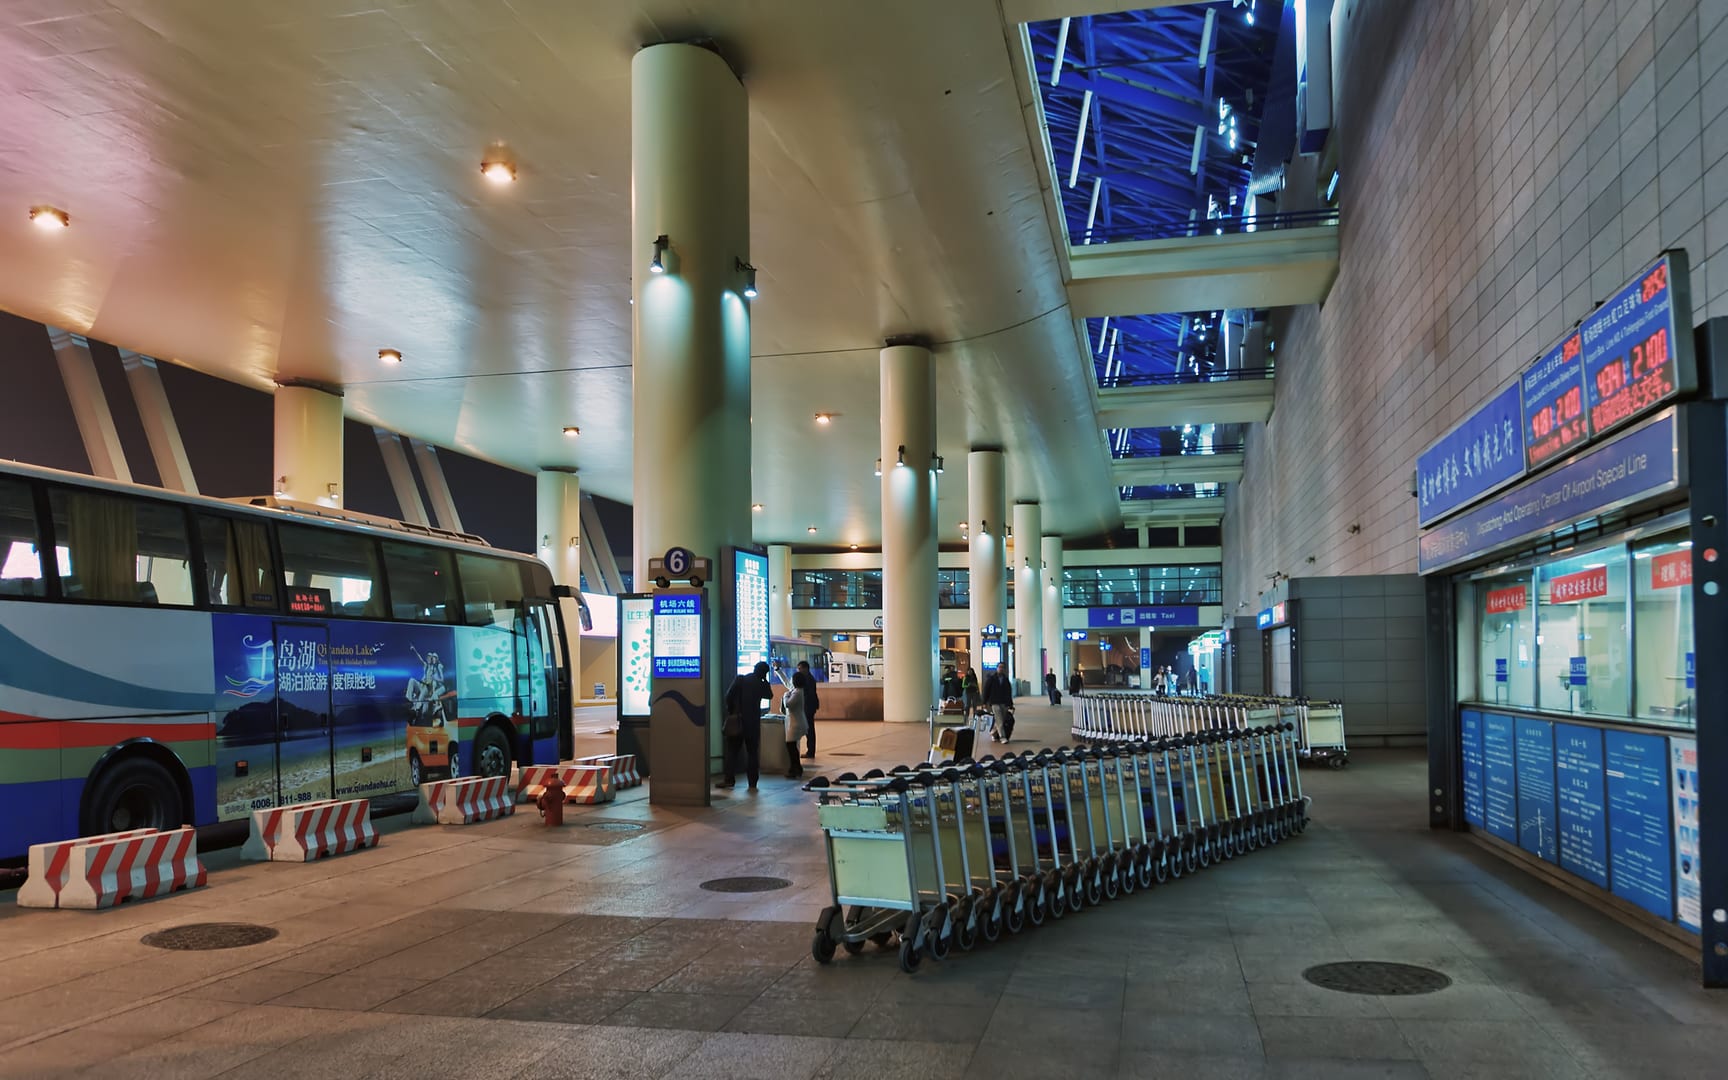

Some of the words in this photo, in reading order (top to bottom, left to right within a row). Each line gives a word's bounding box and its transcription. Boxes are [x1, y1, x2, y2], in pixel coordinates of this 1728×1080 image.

[1572, 473, 1595, 497] Airport
[1597, 459, 1624, 486] Special
[1627, 448, 1646, 472] Line
[669, 551, 684, 573] 6
[659, 599, 695, 608] 机场六线
[988, 625, 995, 634] 8
[355, 644, 374, 656] Lake
[278, 672, 376, 691] 湖泊旅游度假胜地
